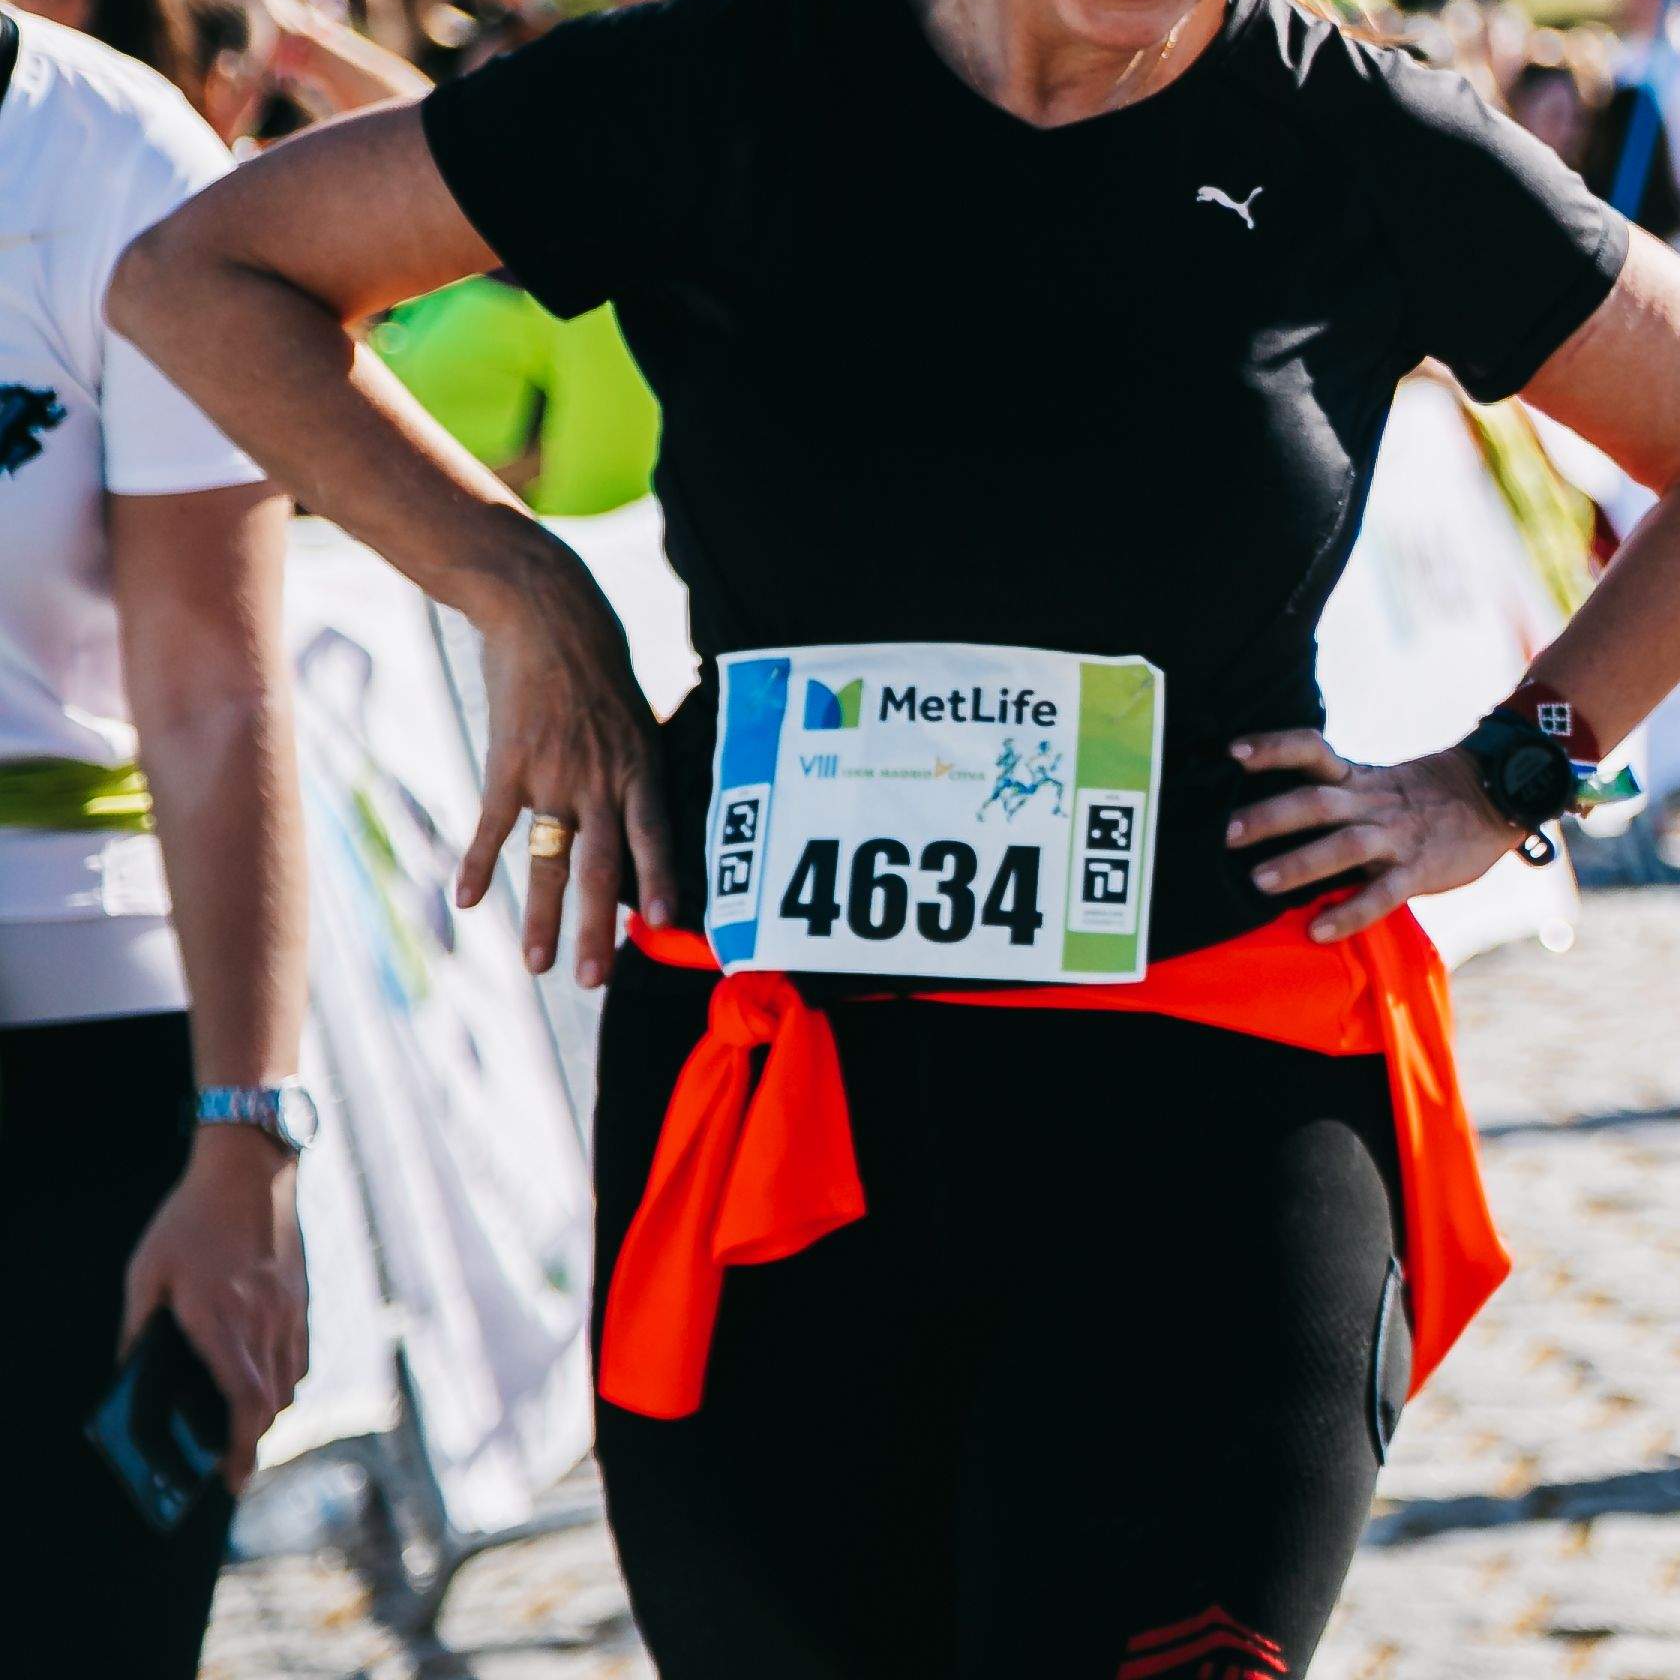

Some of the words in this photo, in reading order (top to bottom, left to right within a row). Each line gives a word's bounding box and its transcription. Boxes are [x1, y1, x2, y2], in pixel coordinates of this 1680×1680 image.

[879, 686, 1058, 727] MetLife
[800, 755, 838, 779] VIII
[779, 837, 1043, 947] 4634
